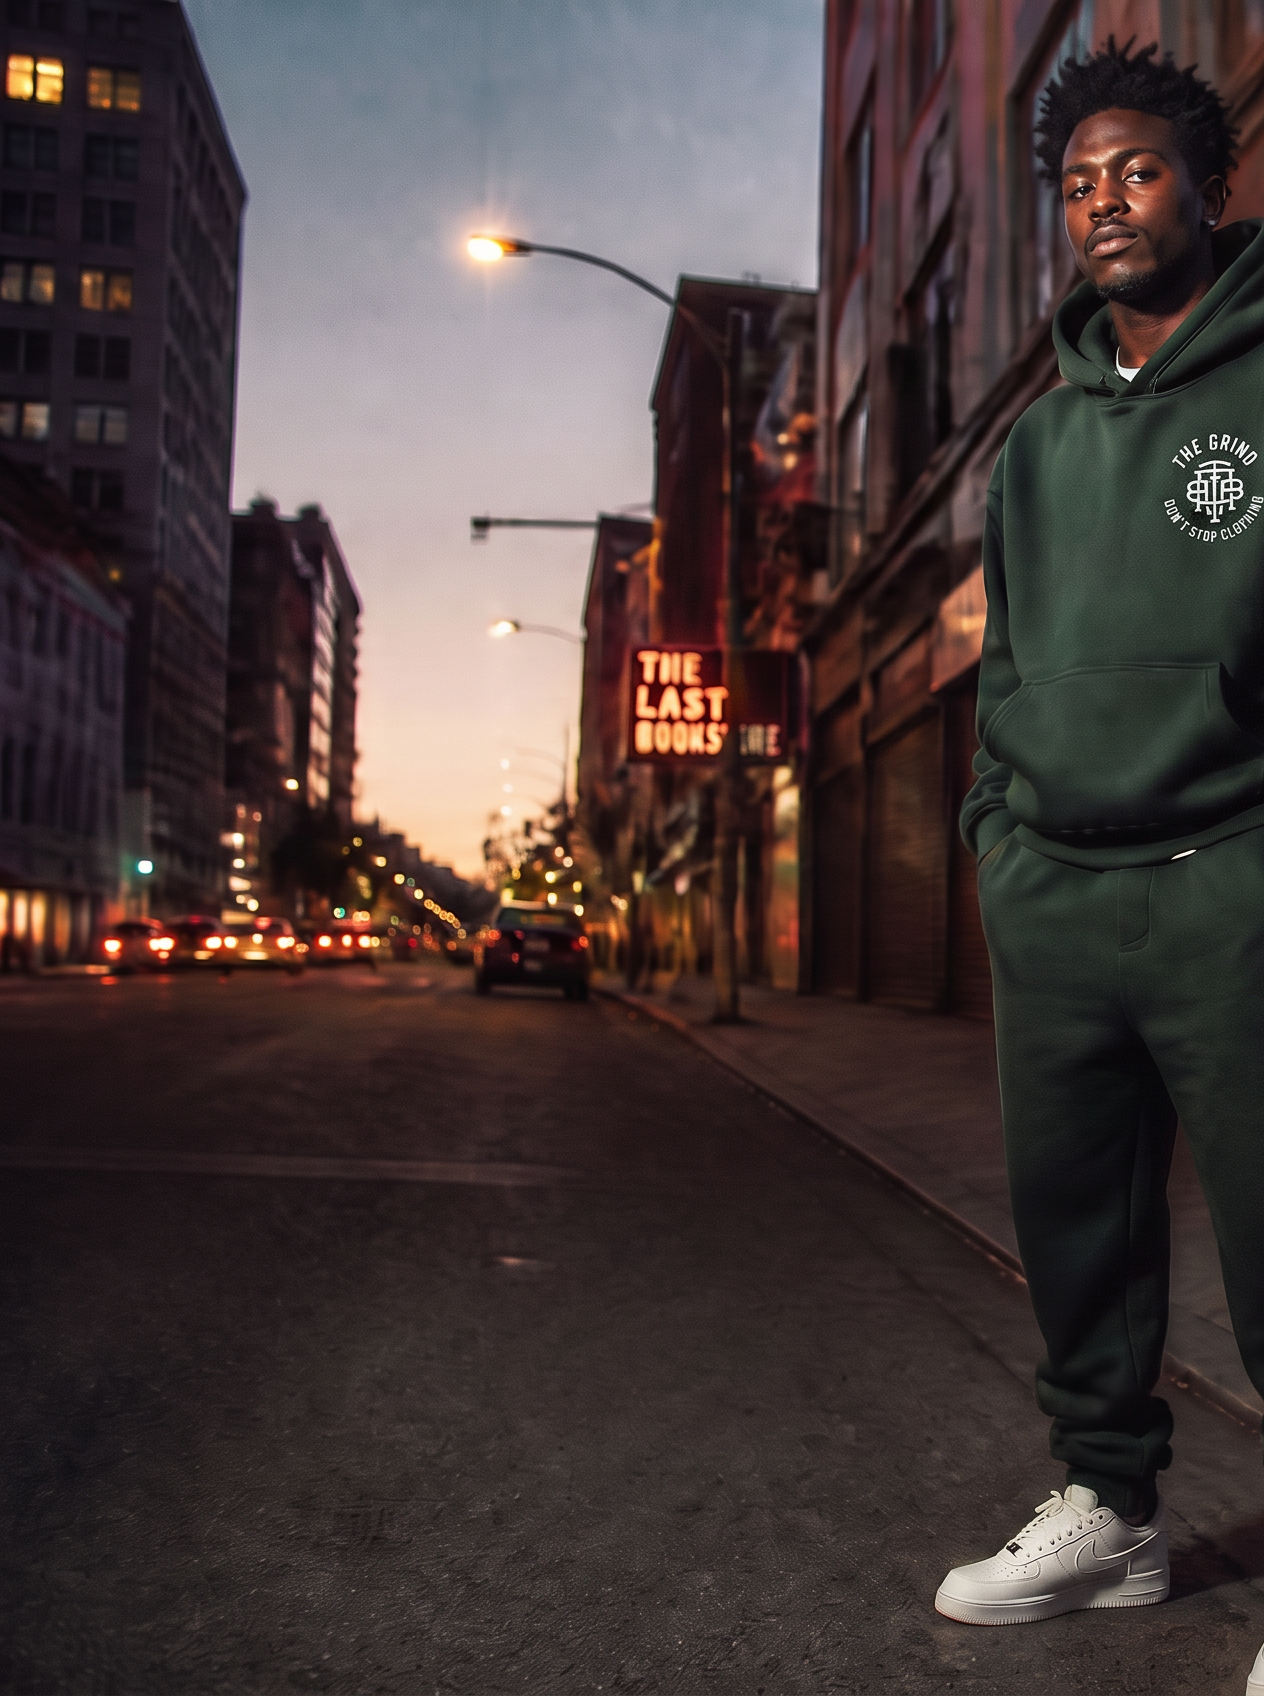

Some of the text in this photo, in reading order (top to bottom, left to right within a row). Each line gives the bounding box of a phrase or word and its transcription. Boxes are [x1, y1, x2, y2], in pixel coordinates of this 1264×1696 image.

[1172, 434, 1258, 468] THE GRIND
[1164, 495, 1264, 542] DON'T STOP CLOTHING
[637, 650, 702, 686] THE
[635, 685, 729, 721] LAST
